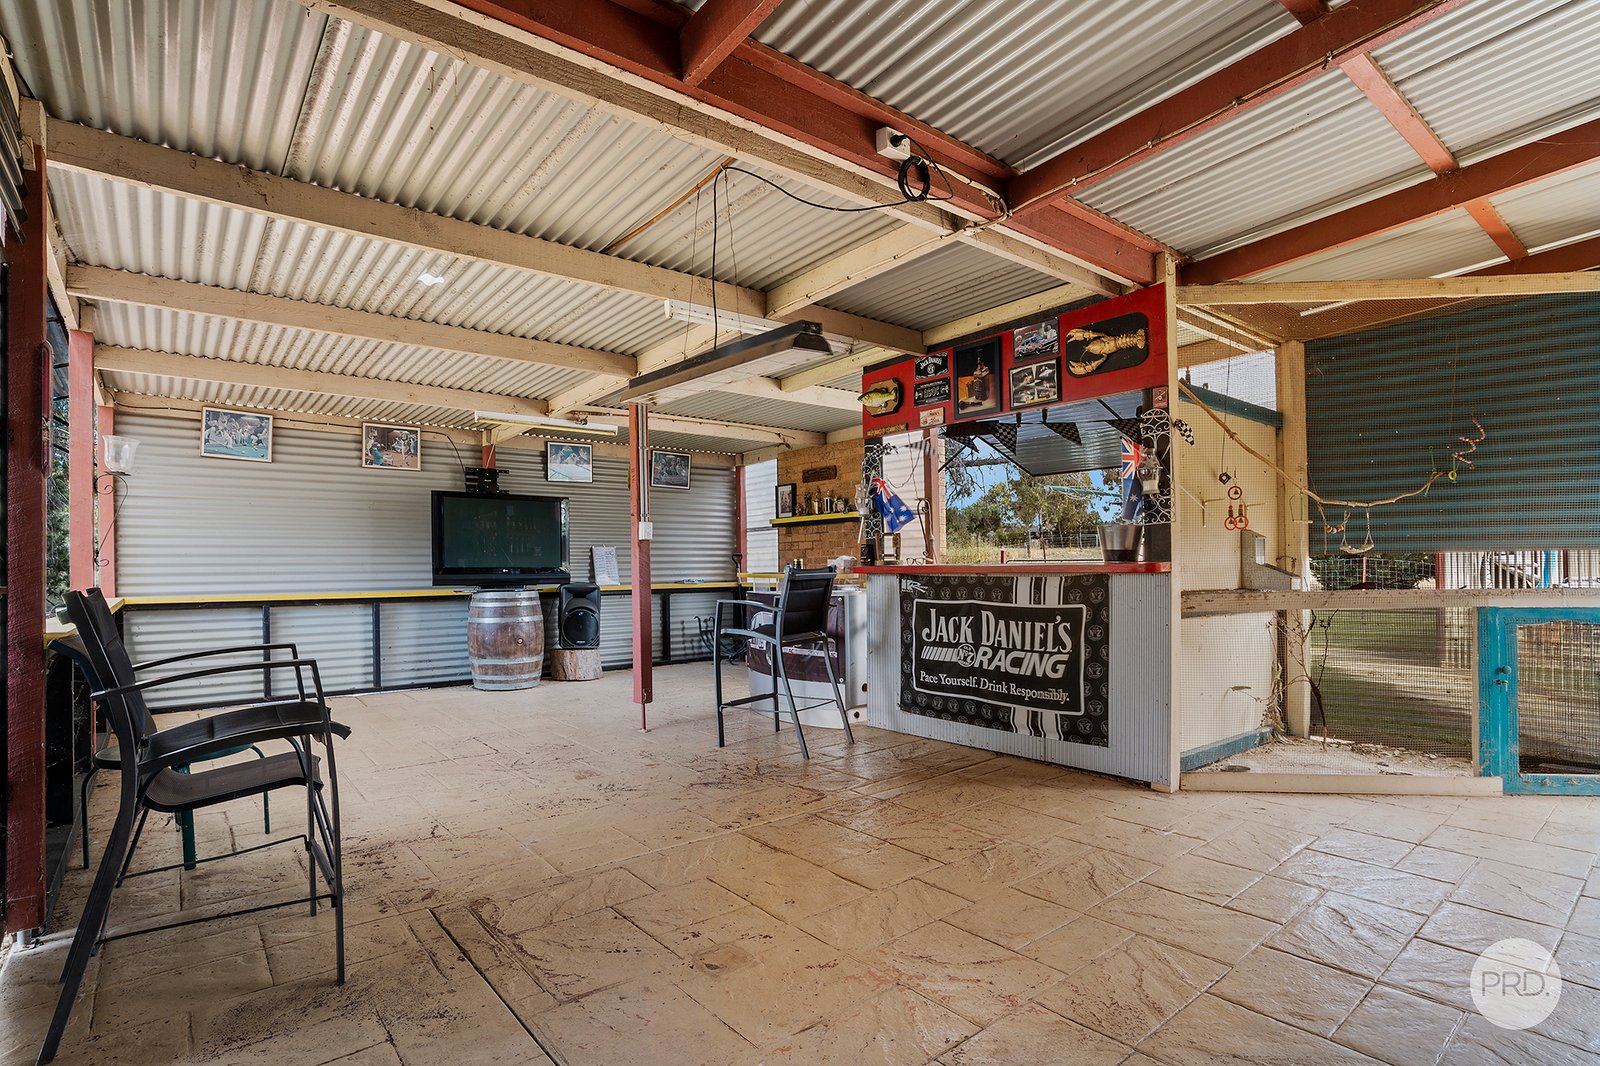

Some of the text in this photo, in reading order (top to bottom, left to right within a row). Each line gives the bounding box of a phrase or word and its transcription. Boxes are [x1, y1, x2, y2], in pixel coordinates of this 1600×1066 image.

[921, 608, 974, 644] JACK
[973, 646, 1070, 678] RACING
[919, 671, 1070, 704] Pace Yourself. Drink Responsibly.
